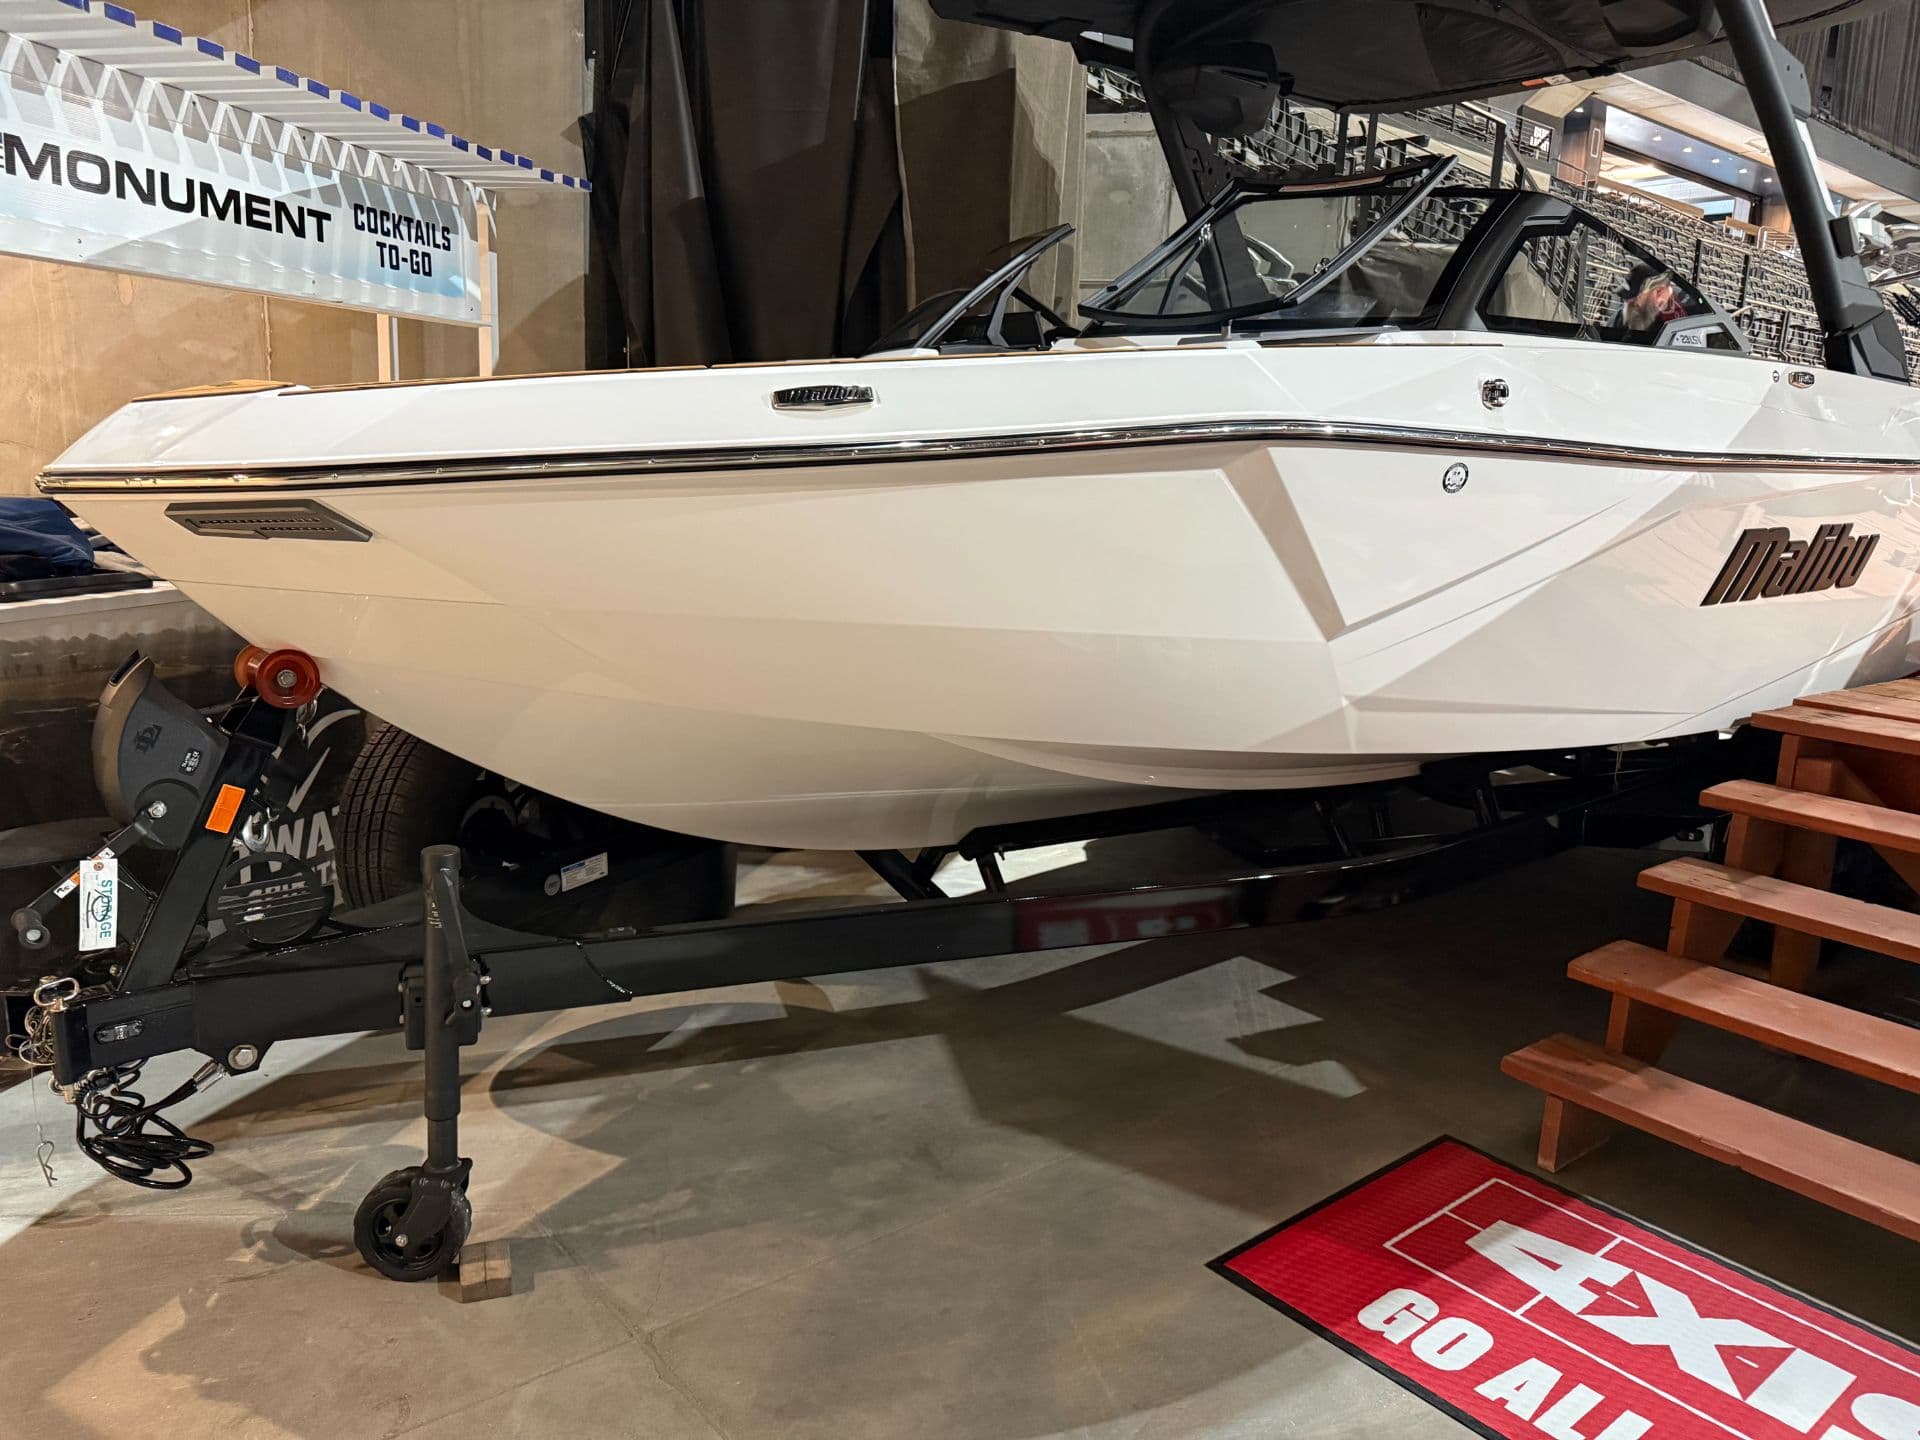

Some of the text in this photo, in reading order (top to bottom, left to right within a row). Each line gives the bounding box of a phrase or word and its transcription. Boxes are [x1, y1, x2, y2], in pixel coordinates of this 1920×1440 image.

[3, 132, 332, 244] MONUMENT
[353, 202, 452, 252] COCKTAILS
[376, 241, 433, 278] TO-GO
[1700, 522, 1881, 607] Malibu
[100, 879, 113, 939] STORAGE
[1356, 1287, 1495, 1371] GO
